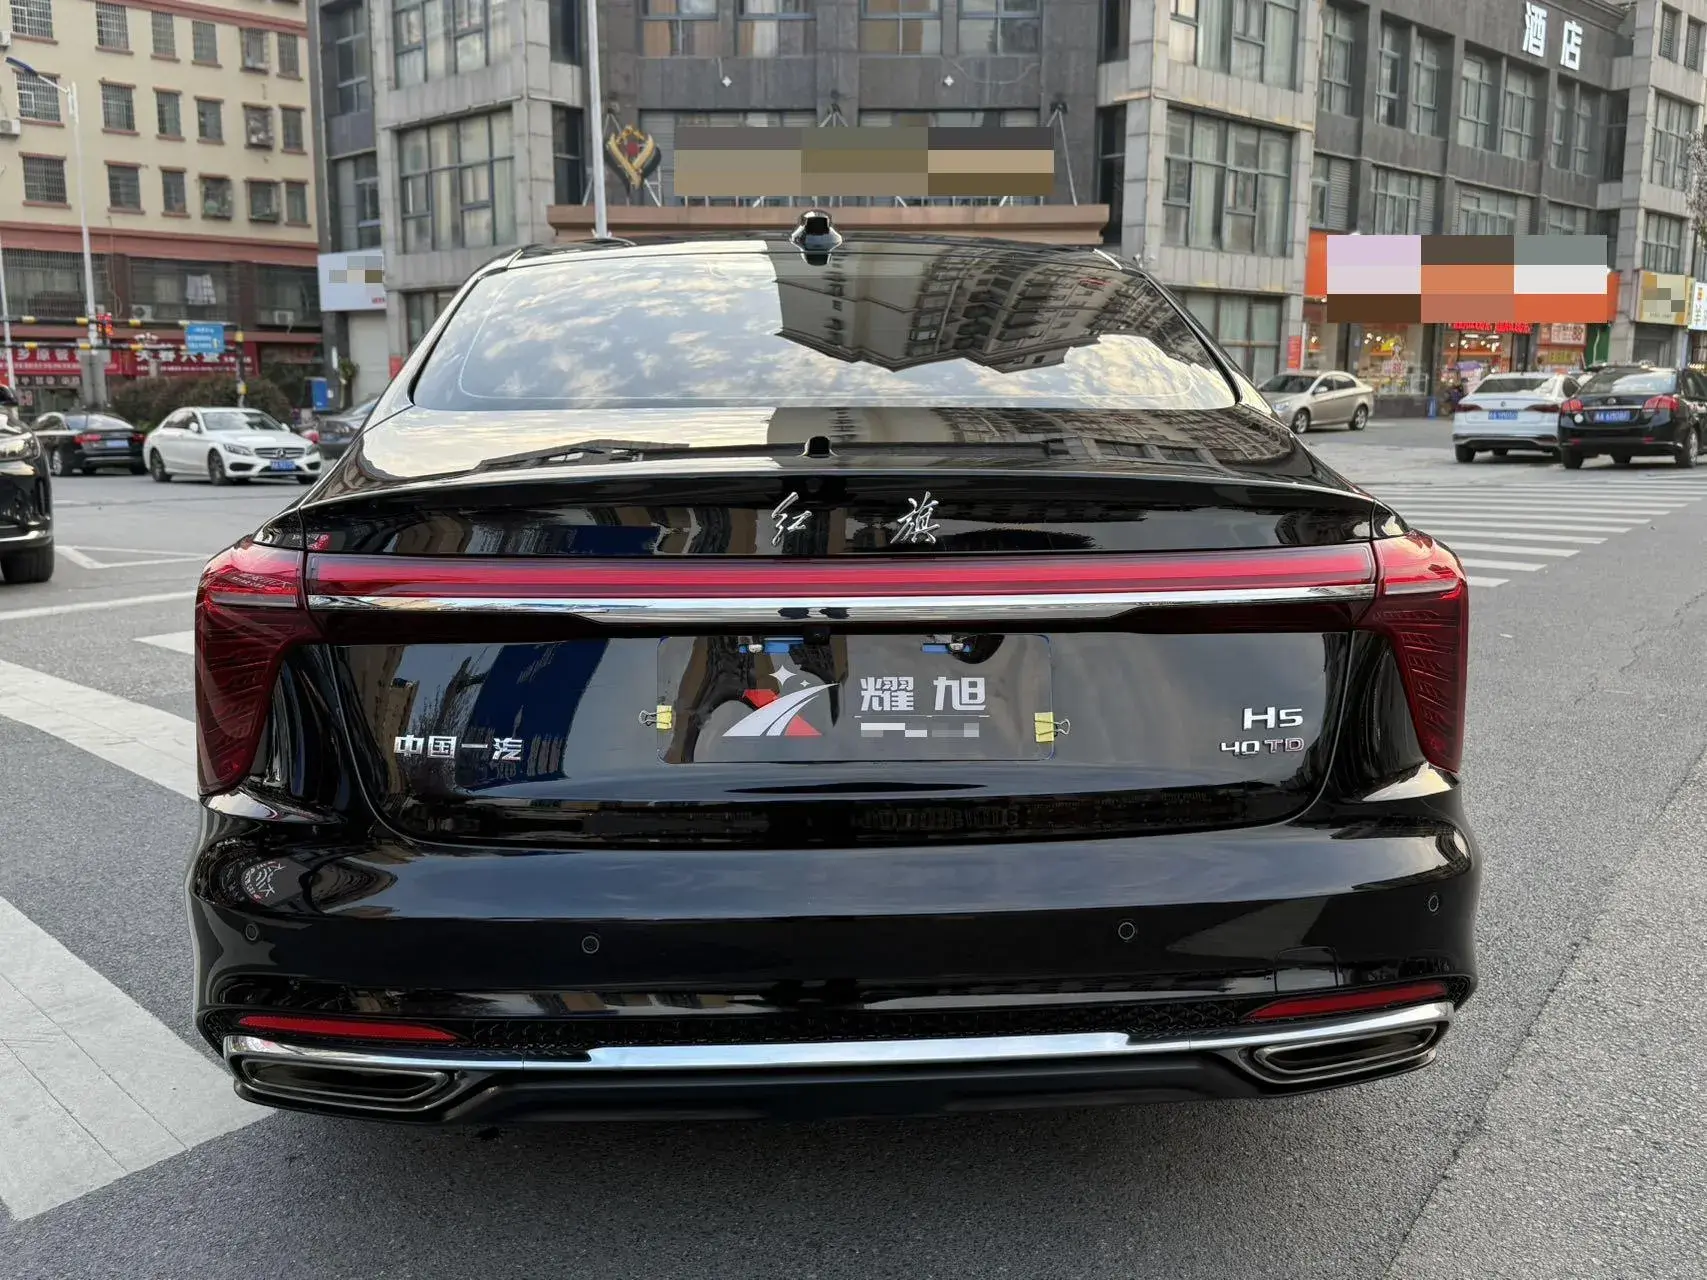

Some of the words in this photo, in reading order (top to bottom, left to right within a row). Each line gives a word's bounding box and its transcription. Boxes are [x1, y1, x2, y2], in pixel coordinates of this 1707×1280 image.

[1522, 1, 1583, 71] 酒店
[771, 491, 941, 544] 红旗
[860, 676, 986, 711] 耀旭
[1243, 706, 1304, 730] H5
[394, 735, 523, 760] 中国一汽
